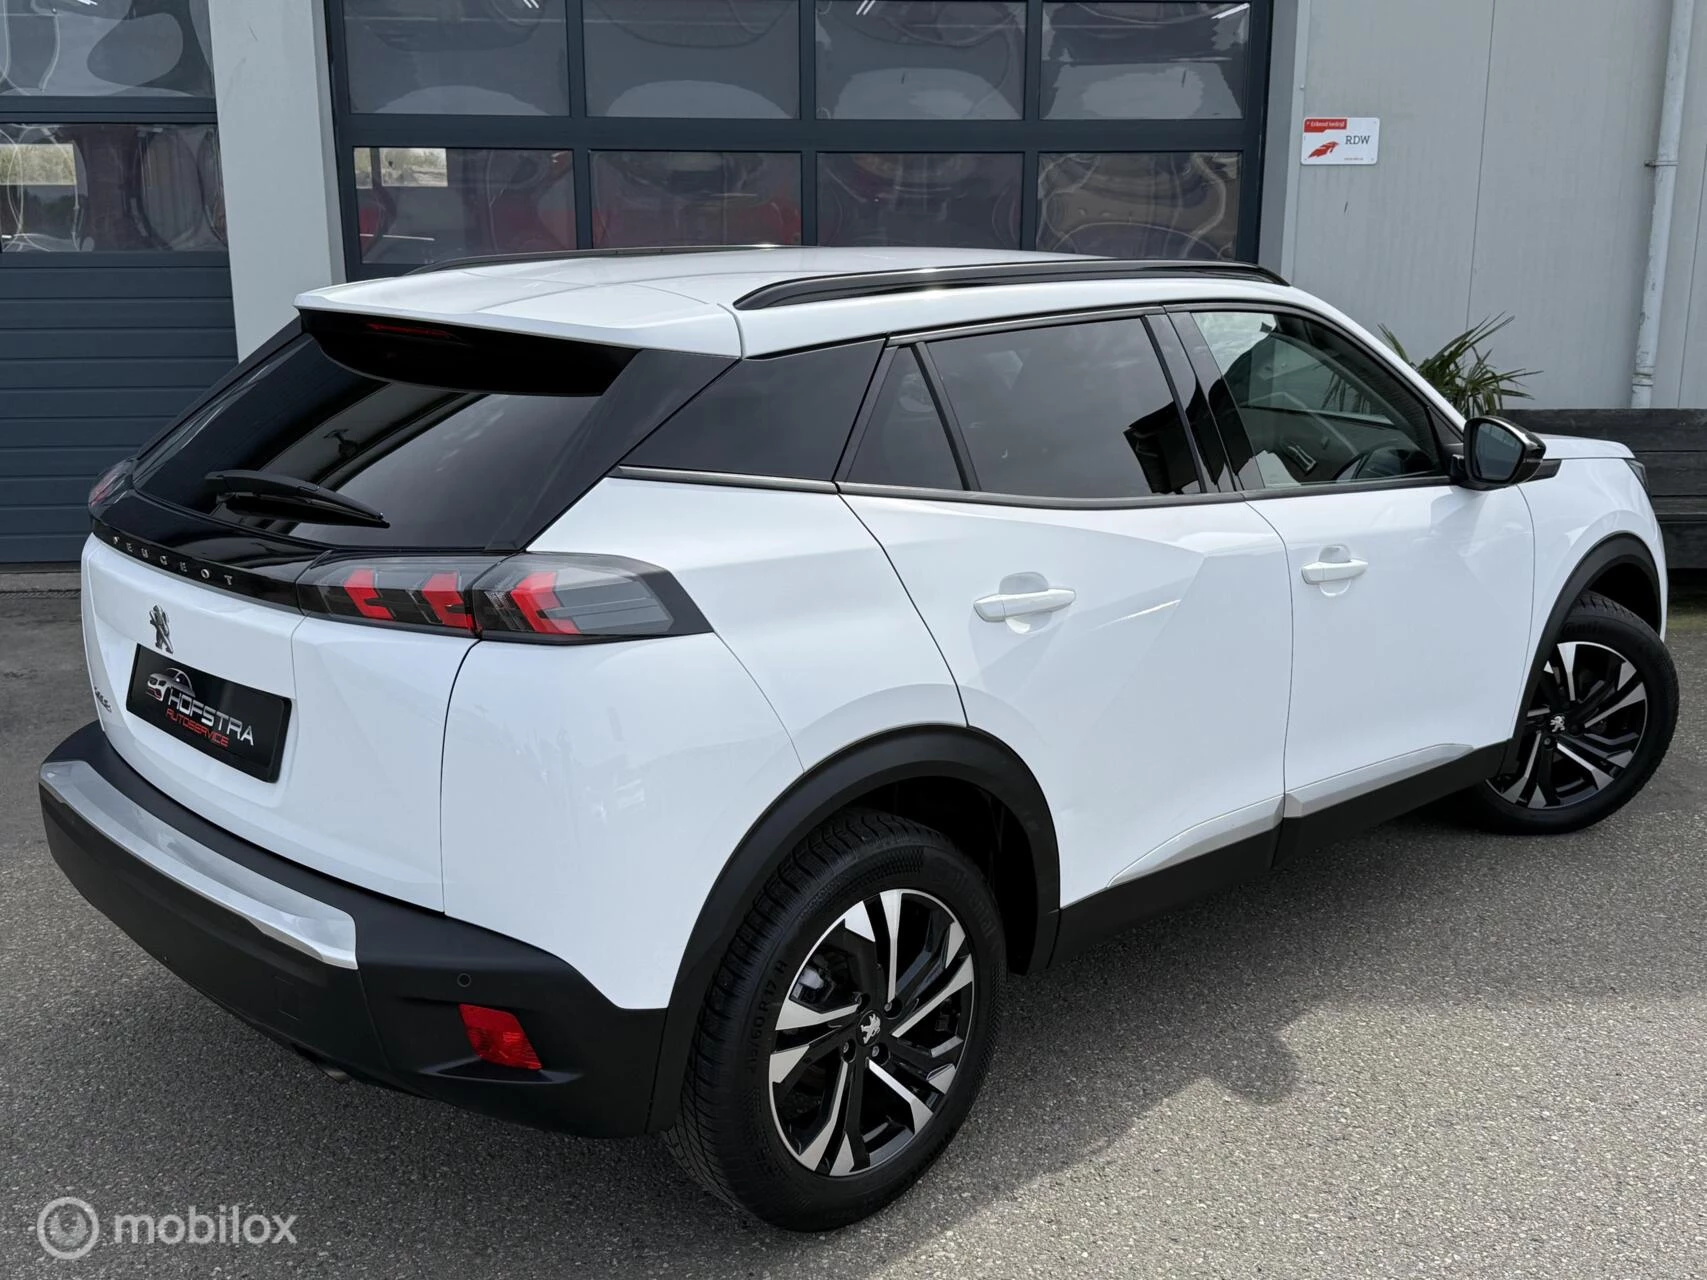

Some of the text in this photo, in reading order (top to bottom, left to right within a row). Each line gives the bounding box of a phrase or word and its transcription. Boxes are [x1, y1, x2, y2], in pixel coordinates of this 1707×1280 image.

[1345, 135, 1371, 145] RDW
[113, 535, 233, 586] PEUGEOT
[166, 708, 230, 748] AUTOSERVICE
[168, 687, 255, 747] HOFSTRA
